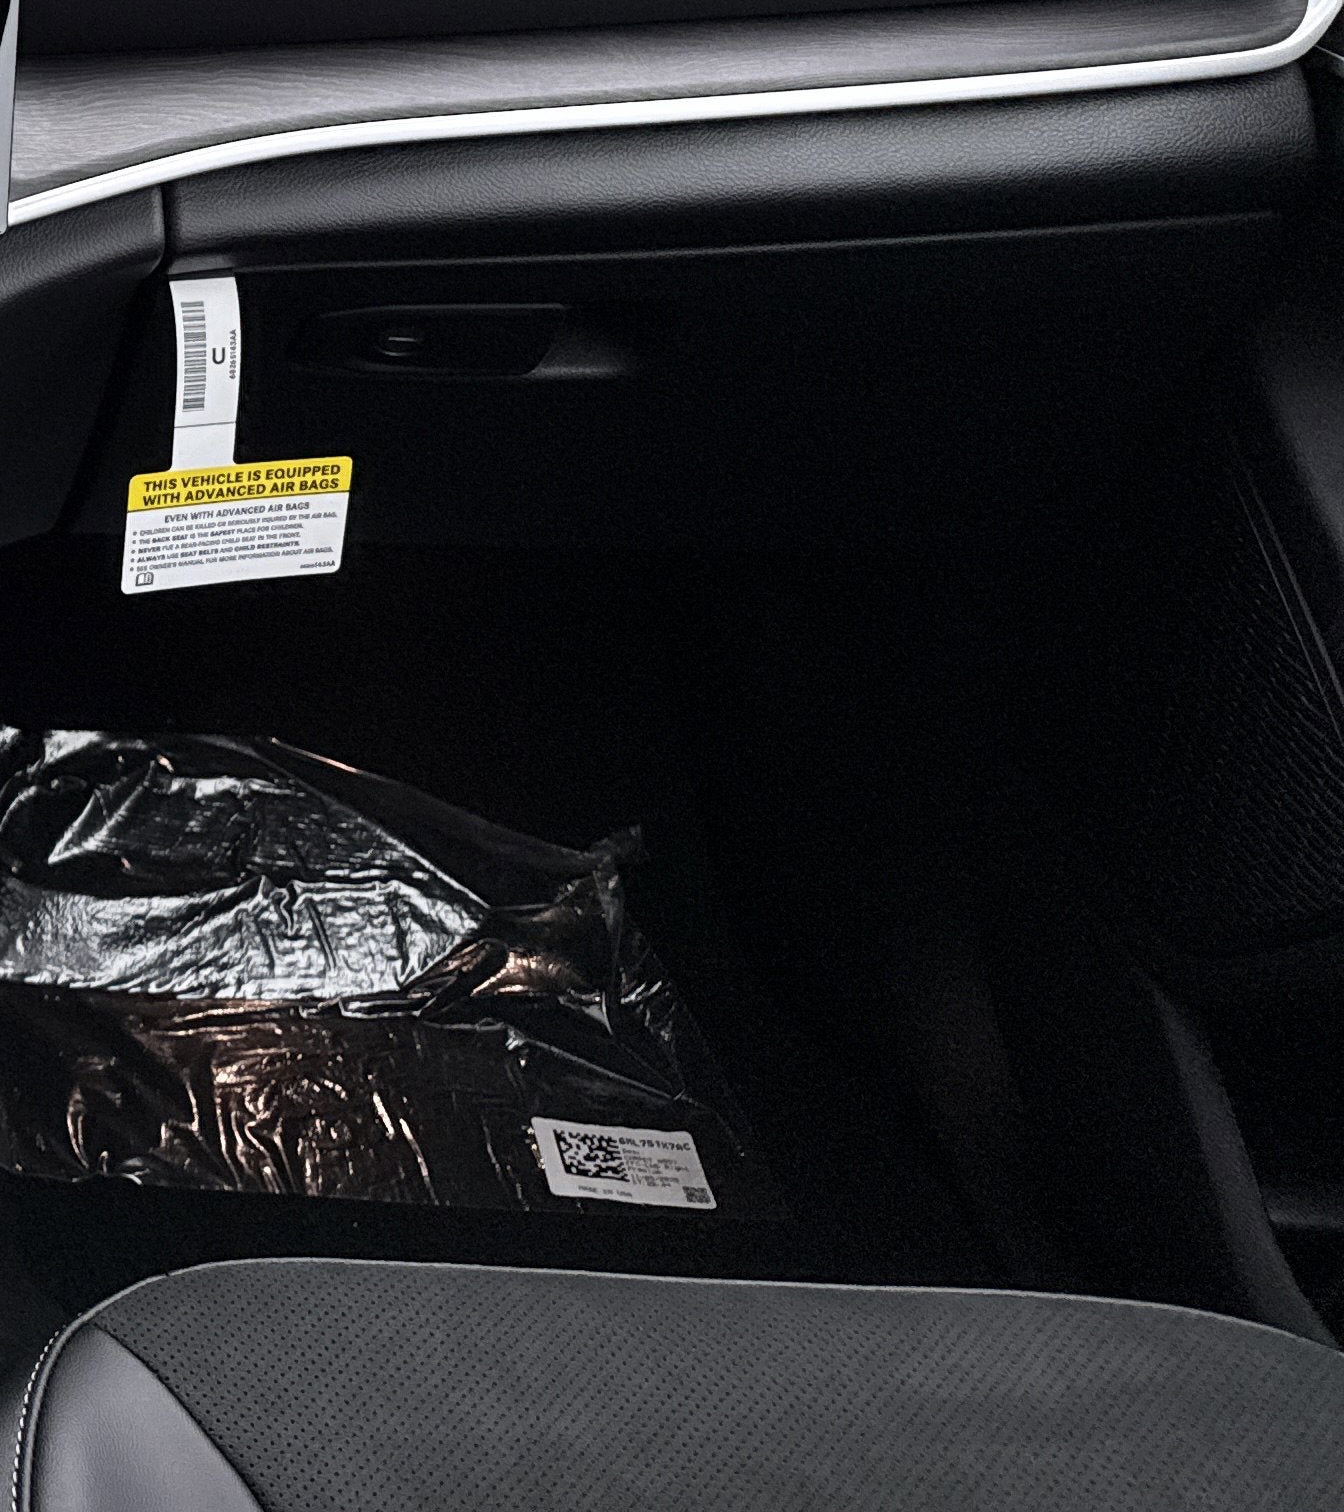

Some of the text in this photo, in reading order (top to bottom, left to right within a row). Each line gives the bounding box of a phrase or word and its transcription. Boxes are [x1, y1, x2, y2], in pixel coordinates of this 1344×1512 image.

[211, 346, 226, 365] U
[143, 464, 341, 493] THIS VEHICLE IS EQUIPPED
[142, 477, 340, 506] WITH ADVANCED AIR BAGS
[164, 501, 310, 523] EVEN WITH ADVANCED AIR BAGS
